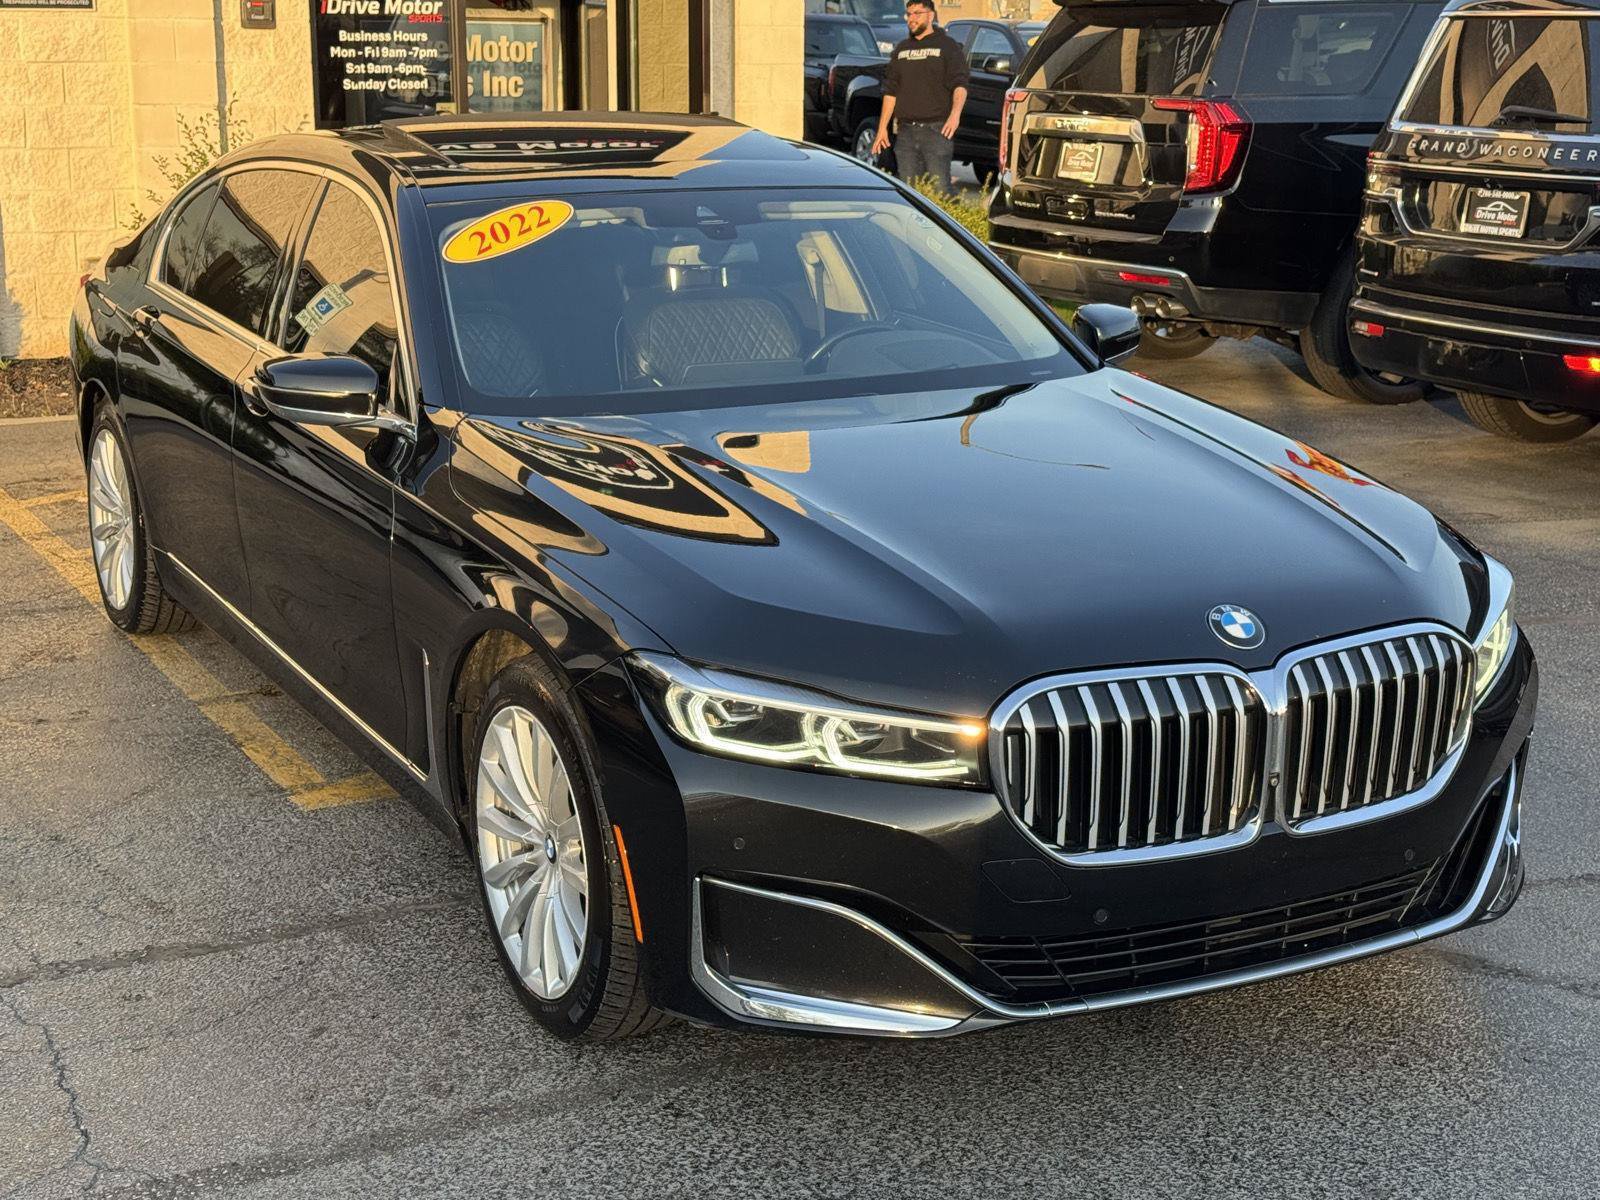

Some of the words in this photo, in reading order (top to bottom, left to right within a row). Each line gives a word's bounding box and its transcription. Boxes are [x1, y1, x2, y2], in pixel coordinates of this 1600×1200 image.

[384, 0, 443, 14] Motor
[408, 14, 443, 23] SPORTS
[338, 30, 391, 42] Business
[393, 31, 428, 42] Hours
[330, 46, 356, 58] Mon
[364, 47, 380, 58] Fri
[381, 46, 407, 58] 9am
[466, 34, 538, 63] Motor
[345, 62, 366, 74] Sat
[367, 63, 393, 74] 9am
[342, 79, 386, 92] Sunday
[388, 79, 428, 90] Closed
[482, 70, 524, 98] Inc
[1408, 139, 1466, 154] GRAND
[1480, 144, 1598, 162] WAGONEER
[1497, 211, 1518, 222] Motor
[468, 205, 551, 256] 2022
[1211, 604, 1251, 621] BMW
